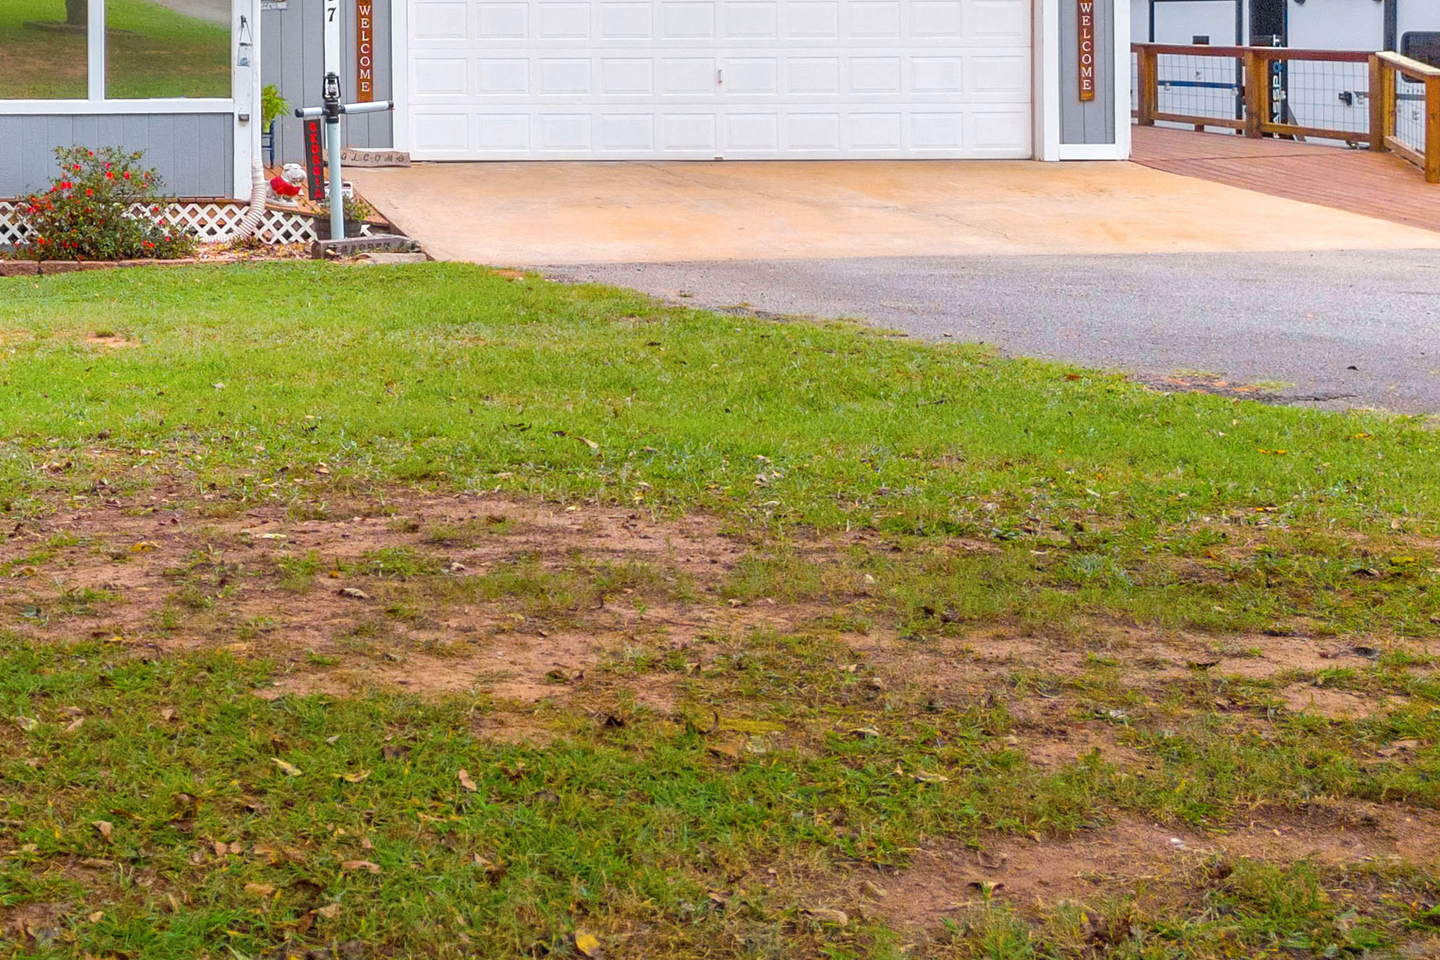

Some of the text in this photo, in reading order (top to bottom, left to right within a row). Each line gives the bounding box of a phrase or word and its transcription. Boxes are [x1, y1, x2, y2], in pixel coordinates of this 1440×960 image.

[359, 5, 371, 92] WELCOME
[1079, 2, 1092, 90] WELCOME
[1272, 33, 1283, 139] PASSPOT
[309, 121, 323, 198] GEORGIA
